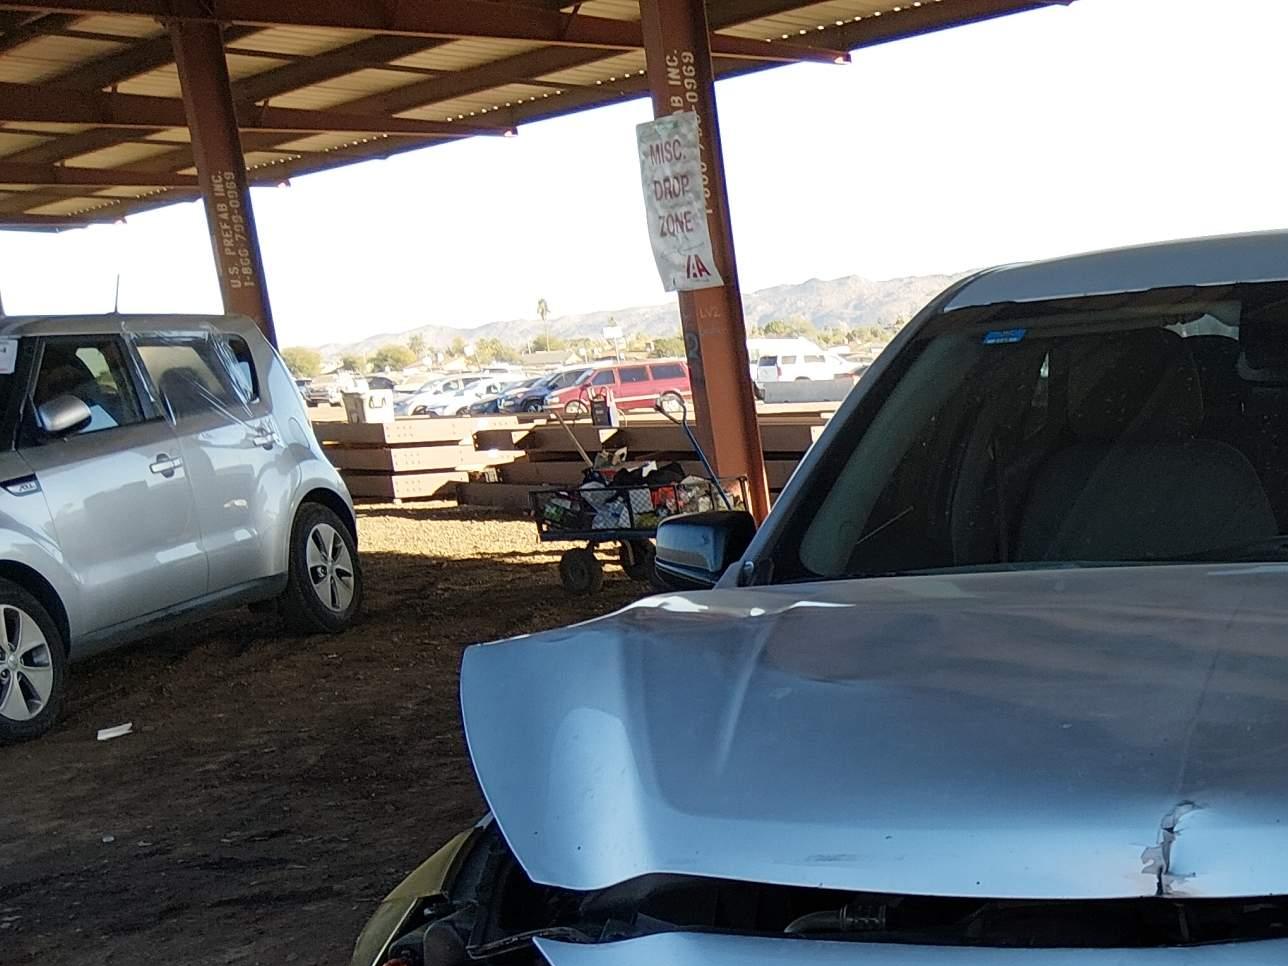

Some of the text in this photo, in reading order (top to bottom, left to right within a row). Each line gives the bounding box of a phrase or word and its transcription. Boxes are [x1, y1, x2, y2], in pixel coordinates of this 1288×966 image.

[666, 50, 681, 86] INC.
[649, 139, 687, 166] MISC.
[211, 171, 226, 197] INC.
[653, 175, 690, 201] DROP
[216, 203, 236, 255] PREFAB
[659, 211, 694, 238] ZONE
